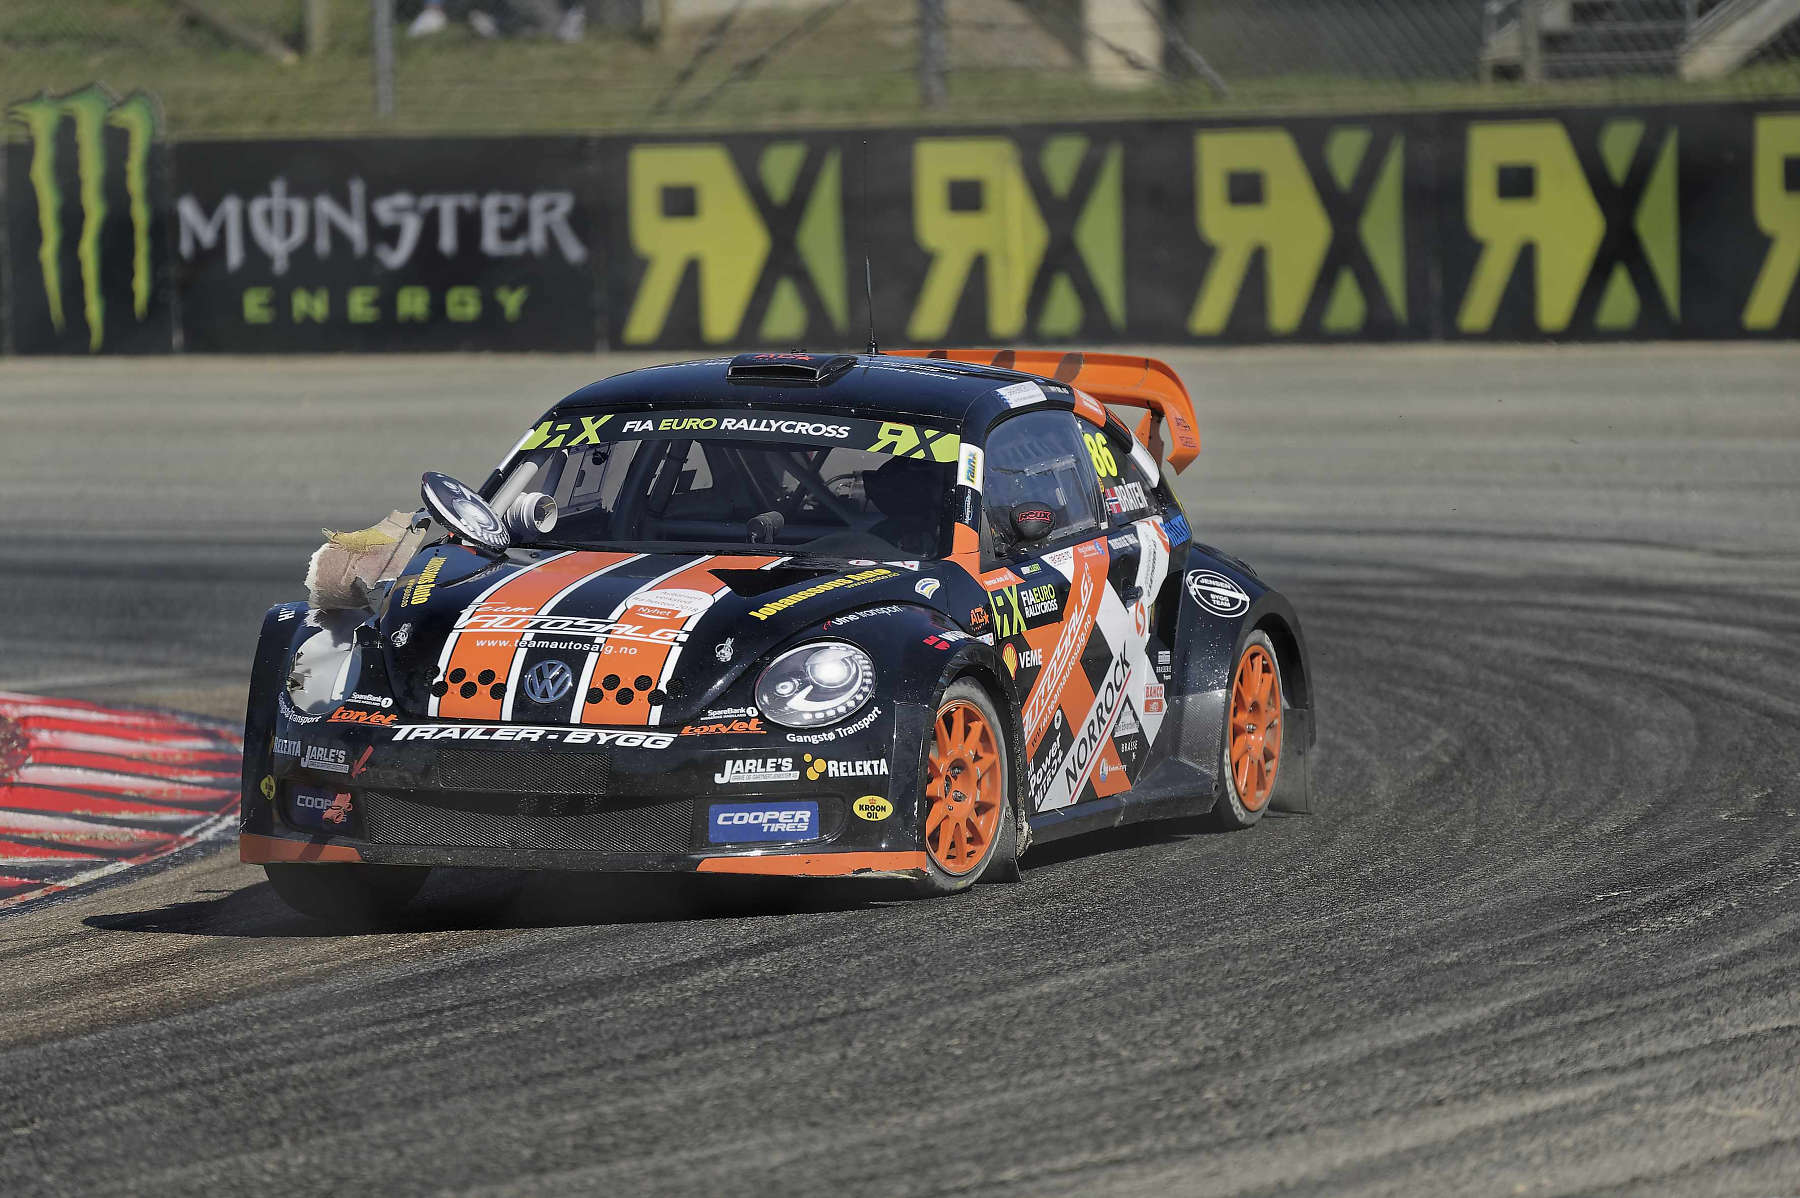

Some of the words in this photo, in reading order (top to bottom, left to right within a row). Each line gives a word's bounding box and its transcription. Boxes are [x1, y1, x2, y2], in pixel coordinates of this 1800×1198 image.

[177, 176, 589, 277] MONSTER
[242, 284, 531, 325] ENERGY
[622, 419, 654, 433] FIA
[658, 417, 718, 431] EURO
[719, 418, 852, 439] RALLYCROSS
[1083, 432, 1119, 478] 86
[1024, 598, 1058, 619] RALLYCROSS
[453, 613, 690, 647] AUTOSALG
[475, 638, 638, 655] www.teamautosalg.no
[1018, 648, 1043, 669] VEME
[707, 707, 746, 718] SpareBank
[1064, 640, 1132, 796] NORROCK
[786, 733, 836, 745] Gangstø
[836, 706, 882, 738] Transport
[300, 745, 346, 768] JARLE'S
[714, 757, 794, 784] JARLE'S
[827, 758, 889, 778] RELEKTA
[716, 810, 811, 826] COOPER
[858, 804, 887, 813] KROON
[866, 811, 879, 820] OIL
[761, 822, 809, 833] TIRES
